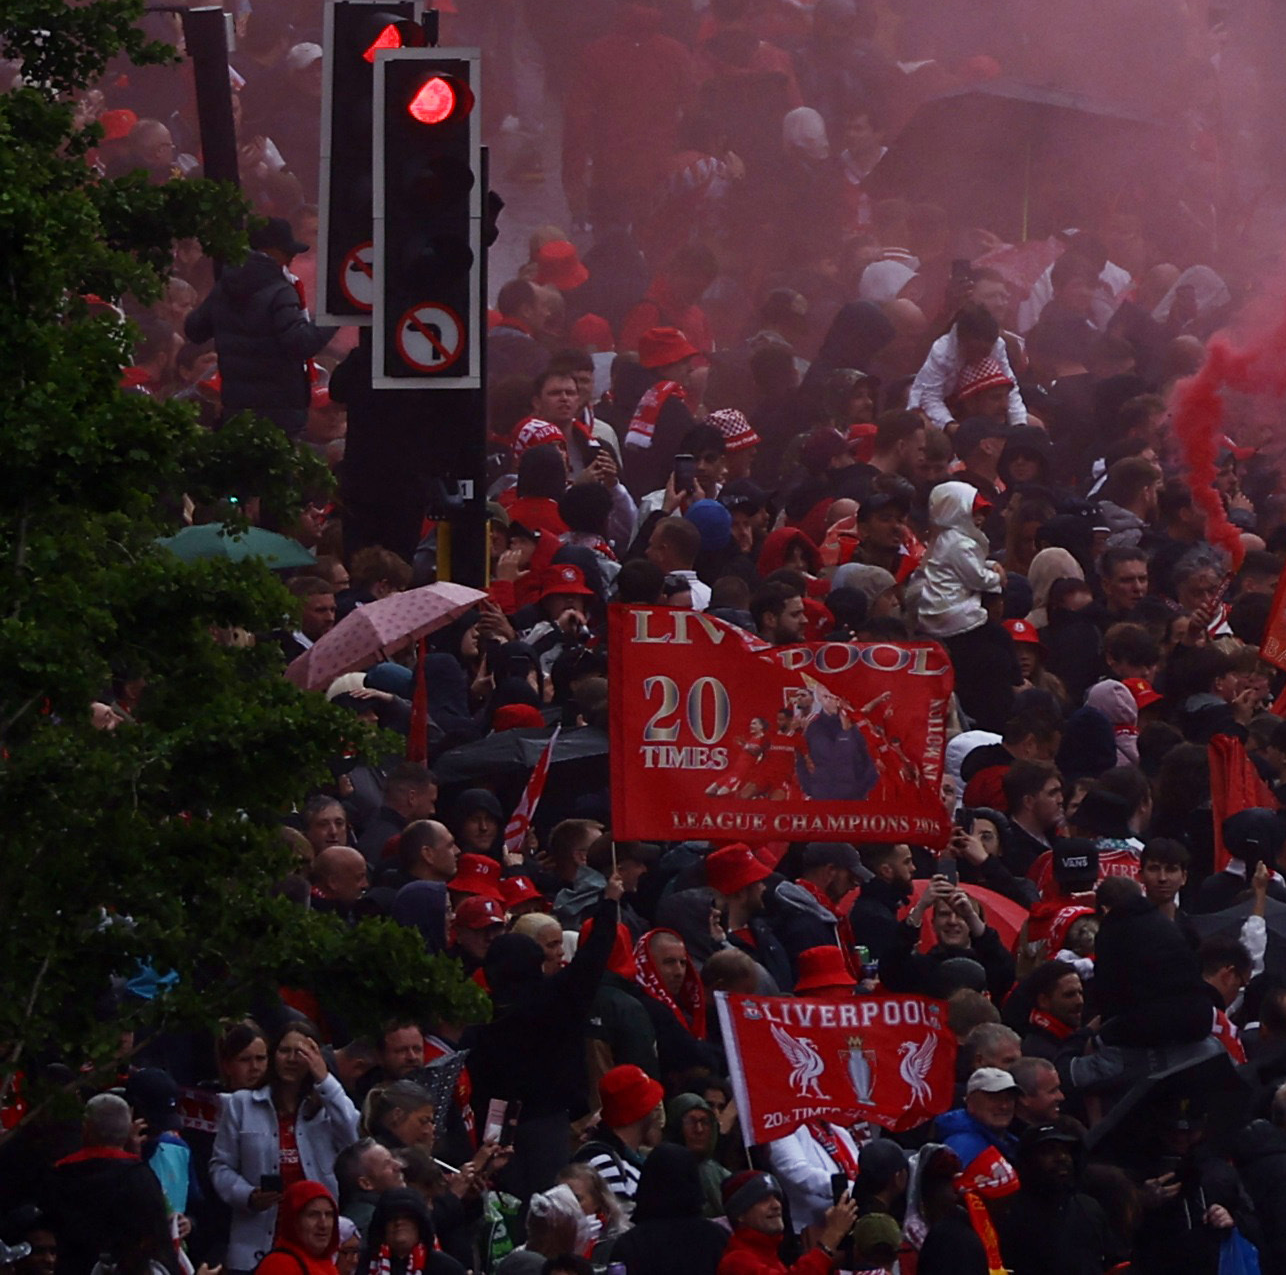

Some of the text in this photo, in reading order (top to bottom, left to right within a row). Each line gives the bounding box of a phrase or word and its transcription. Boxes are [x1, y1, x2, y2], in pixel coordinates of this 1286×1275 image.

[643, 675, 731, 745] 20
[639, 745, 729, 770] TIMES
[672, 811, 769, 832] LEAGUE
[773, 813, 910, 834] CHAMPIONS
[1062, 856, 1089, 868] VANS
[761, 1000, 930, 1027] LIVERPOOL
